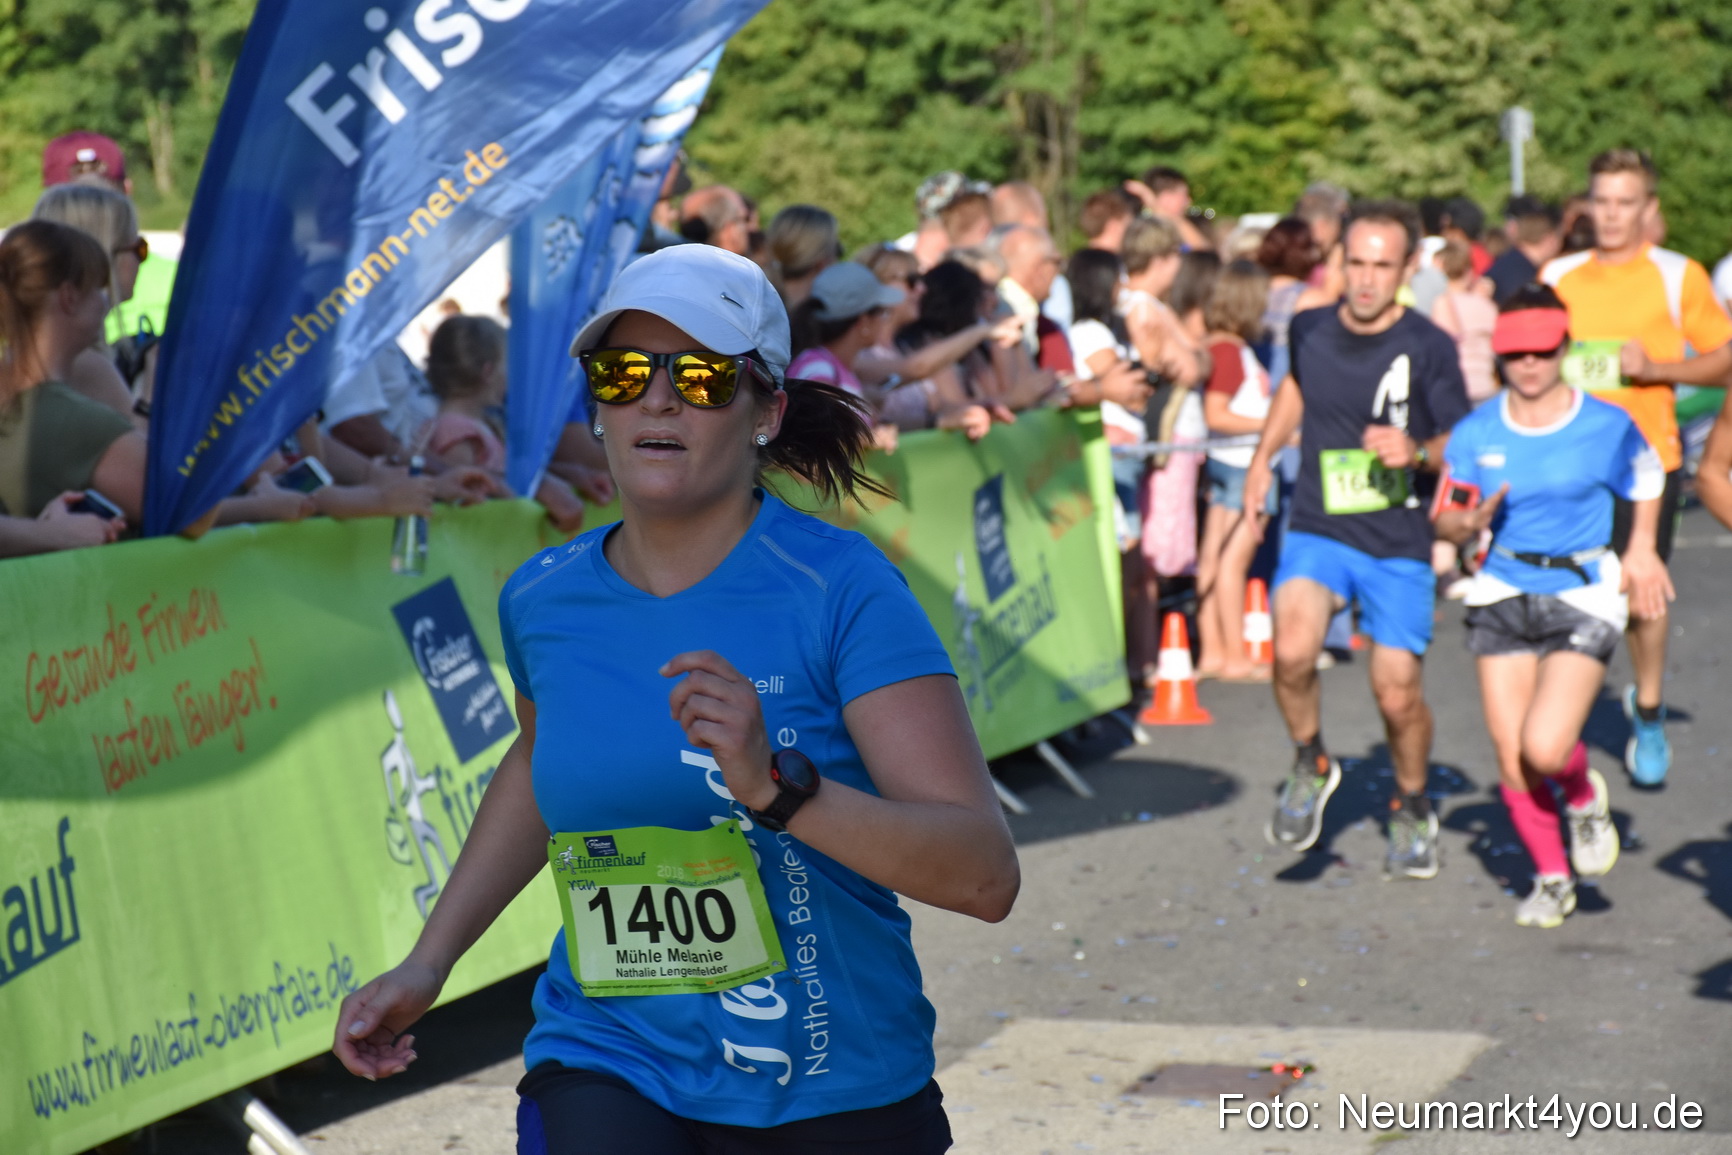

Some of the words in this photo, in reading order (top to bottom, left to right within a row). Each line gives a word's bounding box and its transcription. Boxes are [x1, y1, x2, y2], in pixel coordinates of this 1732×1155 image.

[26, 603, 137, 725] Gesunde
[137, 587, 229, 665] Firmen
[752, 675, 784, 694] elli
[577, 851, 647, 869] firmenlauf
[0, 815, 81, 982] auf
[588, 885, 736, 945] 1400
[616, 949, 662, 964] Mühle
[667, 948, 723, 964] Melanie
[616, 968, 657, 979] Nathalie
[660, 965, 728, 979] Lengenfelder
[795, 933, 830, 1076] Nathalies
